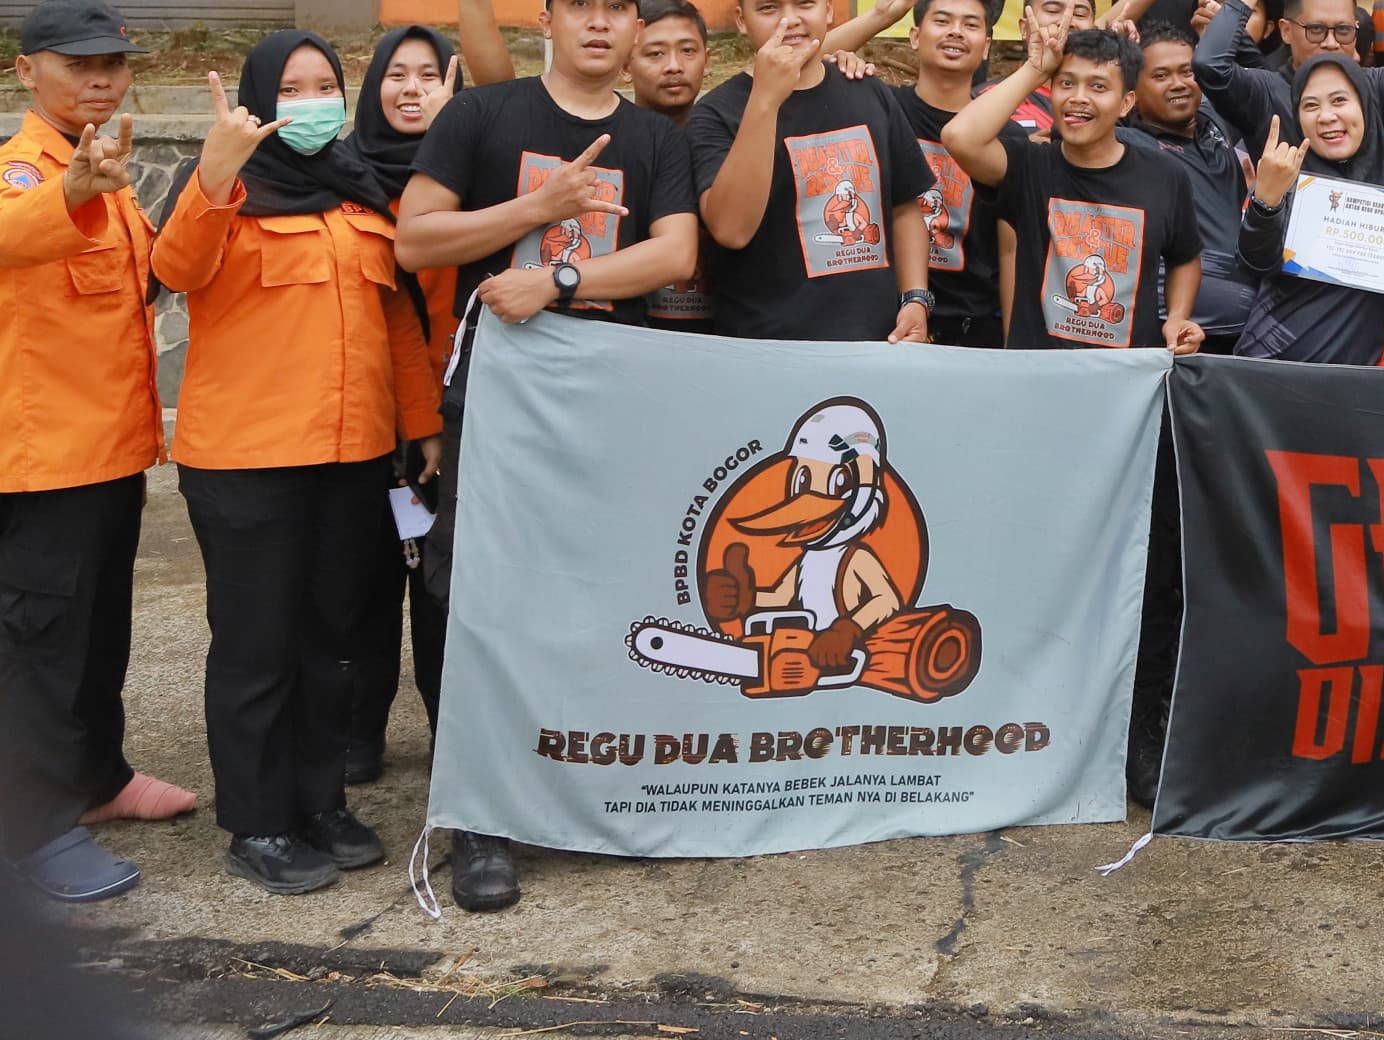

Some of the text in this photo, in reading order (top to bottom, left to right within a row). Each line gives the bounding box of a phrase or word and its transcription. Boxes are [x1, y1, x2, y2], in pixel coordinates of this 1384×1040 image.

[1323, 216, 1357, 227] HADIAH
[1054, 323, 1115, 339] BROTHERHOOD
[1066, 317, 1106, 330] REGU DUA
[674, 439, 763, 605] BPBD KOTA BOGOR
[533, 722, 1050, 766] REGU DUA BROTHERHOOD
[722, 781, 781, 795] KATANYA
[784, 777, 827, 792] BEBEK
[830, 774, 887, 788] JALANYA
[890, 775, 942, 787] LAMBAT
[604, 801, 632, 813] TAPI
[635, 801, 657, 813] DIA
[659, 800, 698, 813] TIDAK
[701, 795, 805, 812] MENINGGALKAN
[808, 793, 853, 806] TEMAN
[856, 791, 881, 803] NYA
[884, 792, 897, 803] DI
